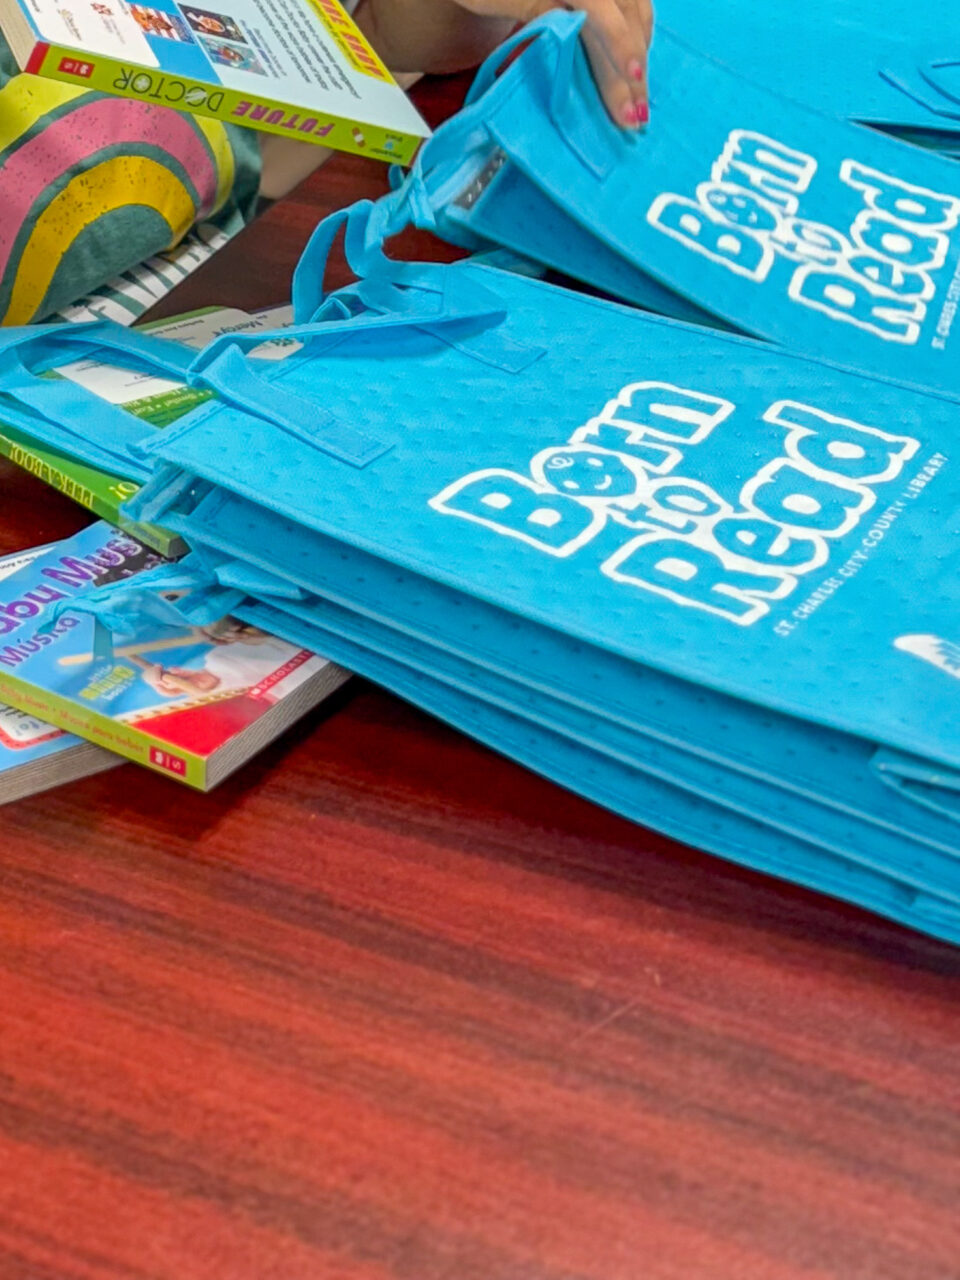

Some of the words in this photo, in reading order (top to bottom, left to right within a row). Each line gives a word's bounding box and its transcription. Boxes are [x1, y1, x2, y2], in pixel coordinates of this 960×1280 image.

[113, 68, 224, 112] DOCTOR
[232, 100, 335, 137] FUTURE
[647, 129, 817, 282] Born
[789, 159, 960, 345] Read
[428, 382, 735, 558] Born
[601, 400, 921, 626] Read
[607, 477, 723, 535] to
[773, 617, 797, 637] ST.
[838, 499, 907, 580] CITY-COUNTY
[901, 451, 951, 500] LIBRARY
[259, 650, 315, 695] SCHOLASTI
